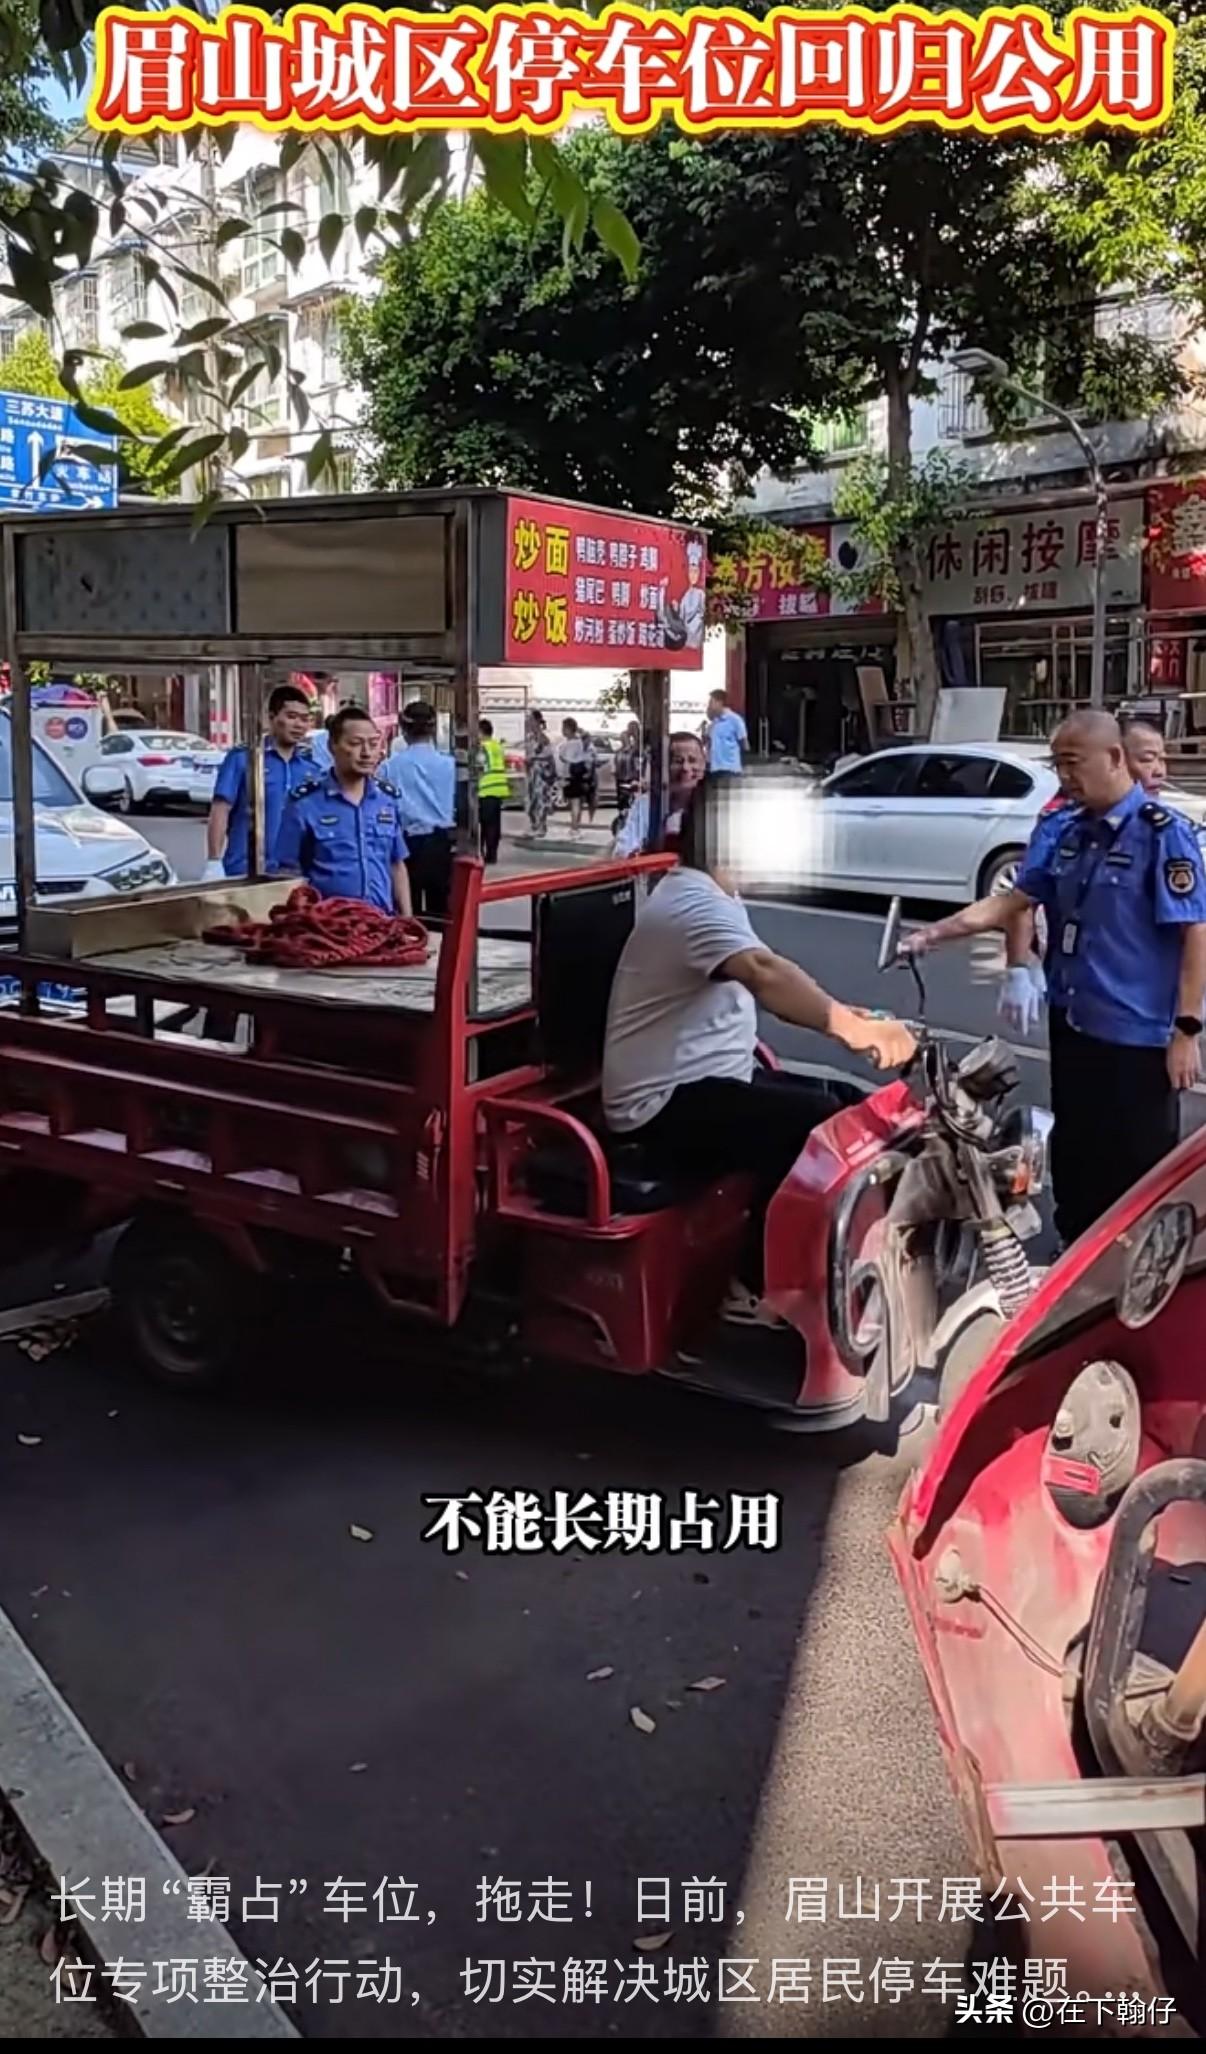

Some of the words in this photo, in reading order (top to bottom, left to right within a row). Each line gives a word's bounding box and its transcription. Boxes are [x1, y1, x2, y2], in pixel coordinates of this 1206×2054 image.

[5, 398, 63, 420] 三苏大道
[514, 518, 571, 576] 炒面
[926, 518, 1121, 582] 休闲按摩
[513, 590, 569, 645] 炒饭
